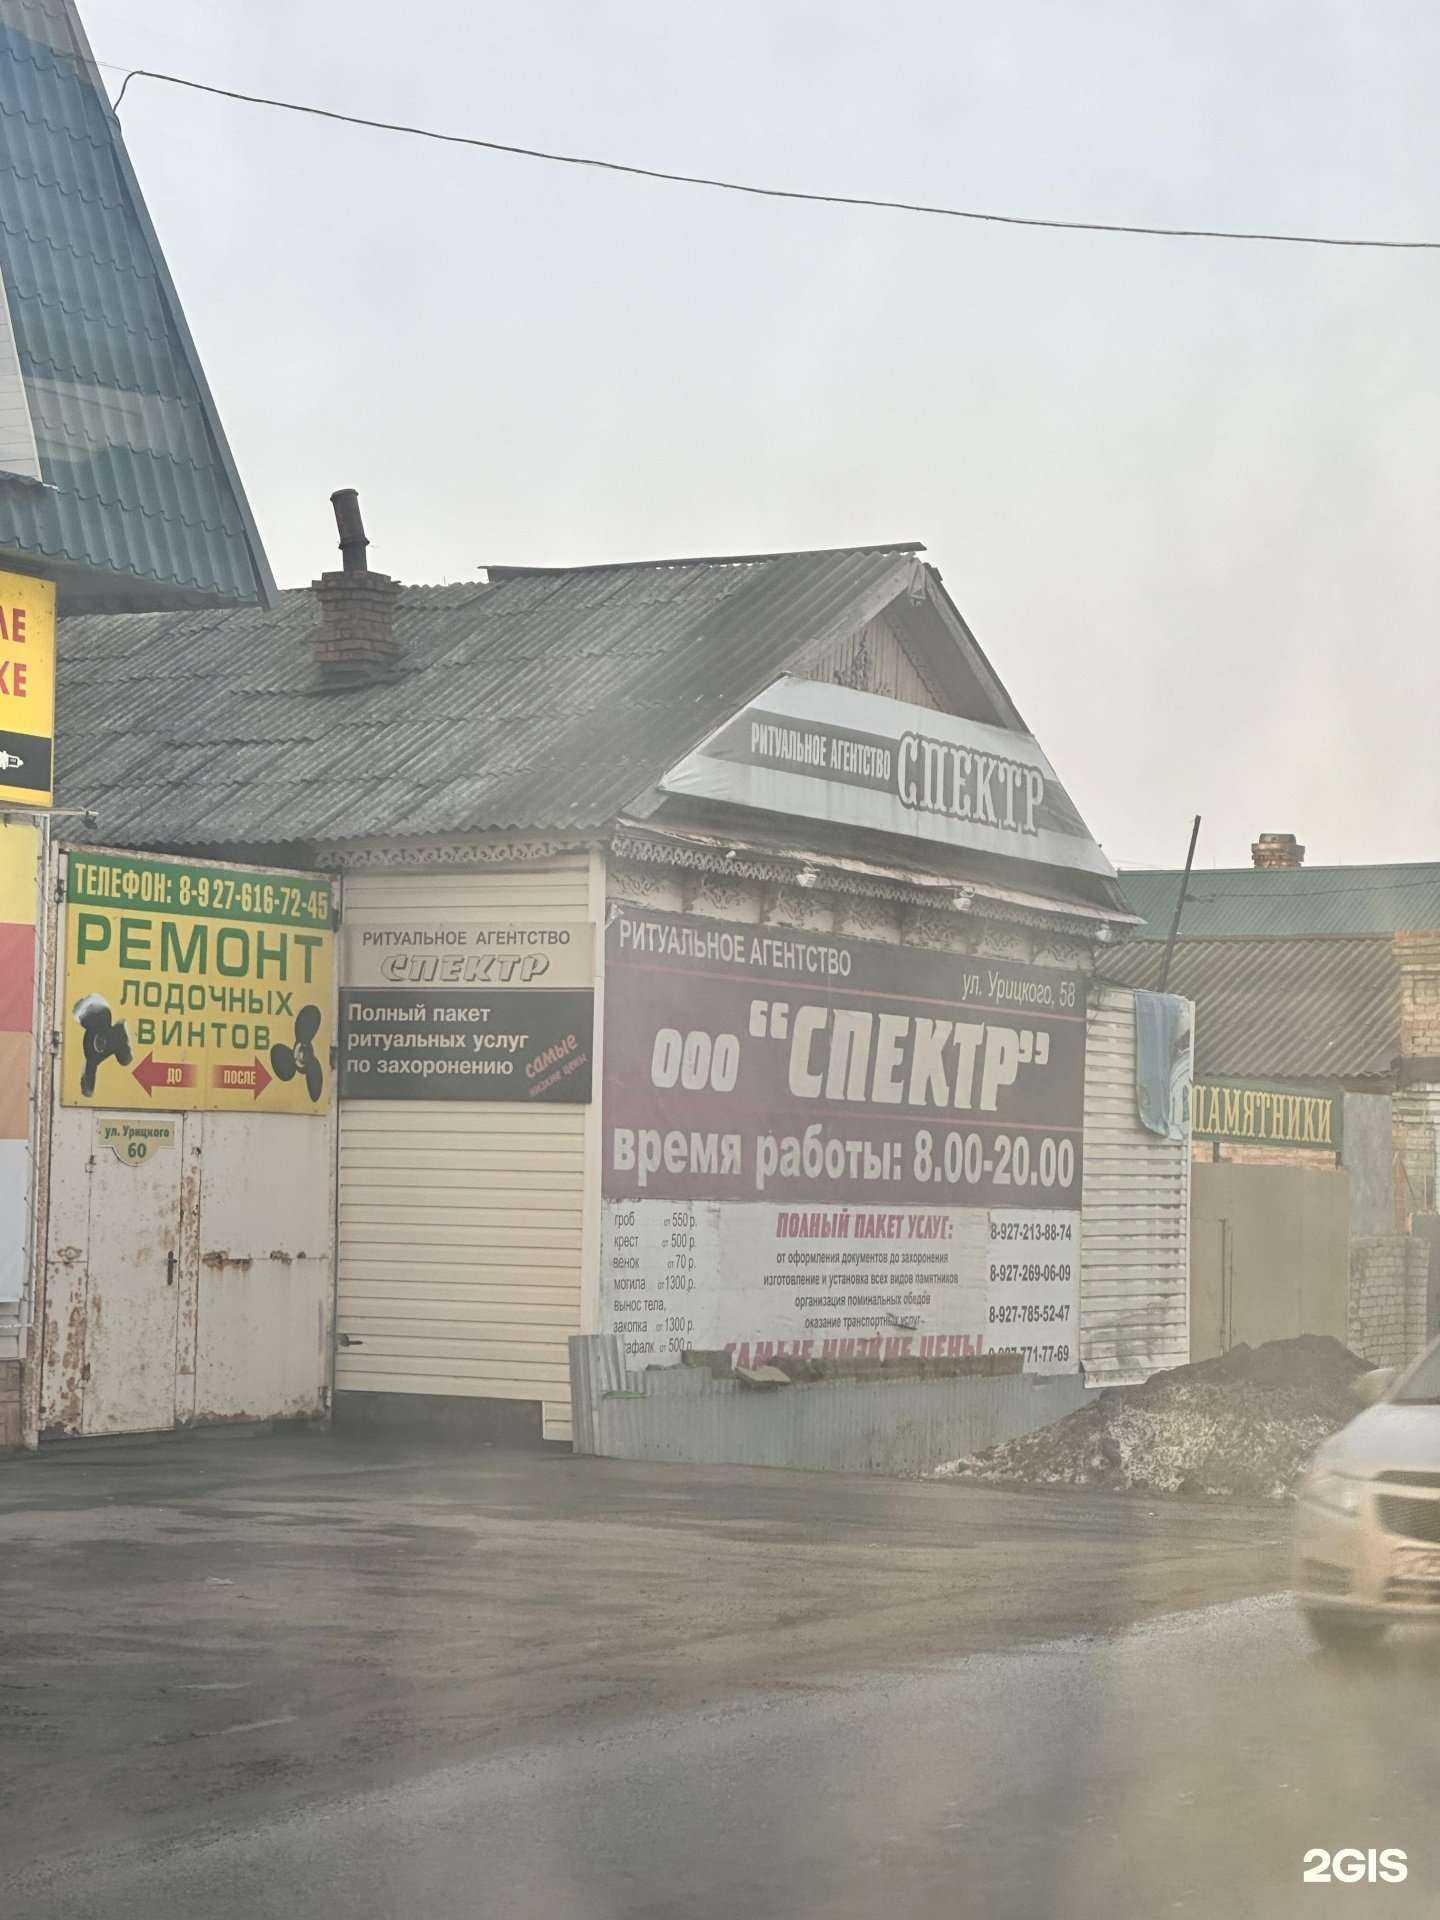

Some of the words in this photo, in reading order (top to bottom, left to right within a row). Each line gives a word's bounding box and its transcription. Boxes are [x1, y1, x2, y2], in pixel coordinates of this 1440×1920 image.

[752, 722, 827, 767] РИТУАЛЬНОЕ
[831, 740, 891, 781] АГЕНТСТВО
[898, 732, 1045, 834] СПЕКТР
[75, 863, 172, 904] ТЕЛЕФОН:
[179, 876, 329, 920] 8-927-616-72-45
[362, 930, 467, 946] РИТУАЛЬНОЕ
[476, 930, 571, 946] АГЕНТСТВО
[76, 912, 323, 984] РЕМОНТ
[619, 919, 745, 965] РИТУАЛЬНОЕ
[750, 938, 852, 977] АГЕНТСТВО
[381, 953, 550, 983] СПЕКТР
[961, 973, 982, 1001] ул.
[988, 970, 1054, 1006] Урицкого,
[1059, 981, 1076, 1008] 58
[120, 980, 294, 1017] ЛОДОЧНЫХ
[348, 1003, 427, 1023] Полный
[433, 1007, 491, 1022] пакет
[137, 1018, 270, 1050] ВИНТОВ
[348, 1032, 466, 1052] ритуальных
[473, 1033, 529, 1052] услуг
[347, 1059, 370, 1073] по
[376, 1059, 514, 1077] захоронению
[651, 1028, 740, 1092] ООО
[166, 1068, 183, 1084] ДО
[223, 1069, 257, 1086] ПОСЛЕ
[1192, 1084, 1332, 1143] ПАМЯТНИКИ
[104, 1127, 120, 1140] ул.
[127, 1142, 147, 1158] 60
[613, 1128, 742, 1187] время
[755, 1124, 902, 1190] работы:
[914, 1129, 1075, 1188] 8.00-20.00
[614, 1211, 635, 1229] гроб
[776, 1208, 851, 1238] ПОЛНЫЙ
[853, 1213, 905, 1239] ПАКЕТ
[907, 1213, 953, 1240] УСЛУГ:
[990, 1222, 1072, 1241] 8-927-213-88-74
[614, 1235, 639, 1251] крест
[671, 1233, 687, 1248] 500
[612, 1257, 640, 1269] венок
[675, 1254, 687, 1269] 70
[776, 1252, 786, 1264] от
[787, 1250, 840, 1267] оформления
[841, 1252, 888, 1266] документов
[889, 1252, 900, 1265] до
[901, 1252, 949, 1266] захоронения
[763, 1274, 820, 1286] изготовление
[821, 1274, 827, 1285] и
[828, 1273, 869, 1288] установка
[870, 1273, 888, 1285] всех
[890, 1273, 914, 1286] видов
[915, 1273, 959, 1285] памятников
[990, 1264, 1071, 1282] 8-927-269-06-09
[614, 1278, 646, 1290] могила
[665, 1275, 686, 1290] 1300
[613, 1299, 642, 1312] вынос
[794, 1296, 846, 1310] организация
[847, 1295, 902, 1306] поминальных
[989, 1304, 1070, 1323] 8-927-785-52-47
[613, 1320, 648, 1333] закопка
[665, 1317, 685, 1332] 1300
[804, 1317, 842, 1329] оказание
